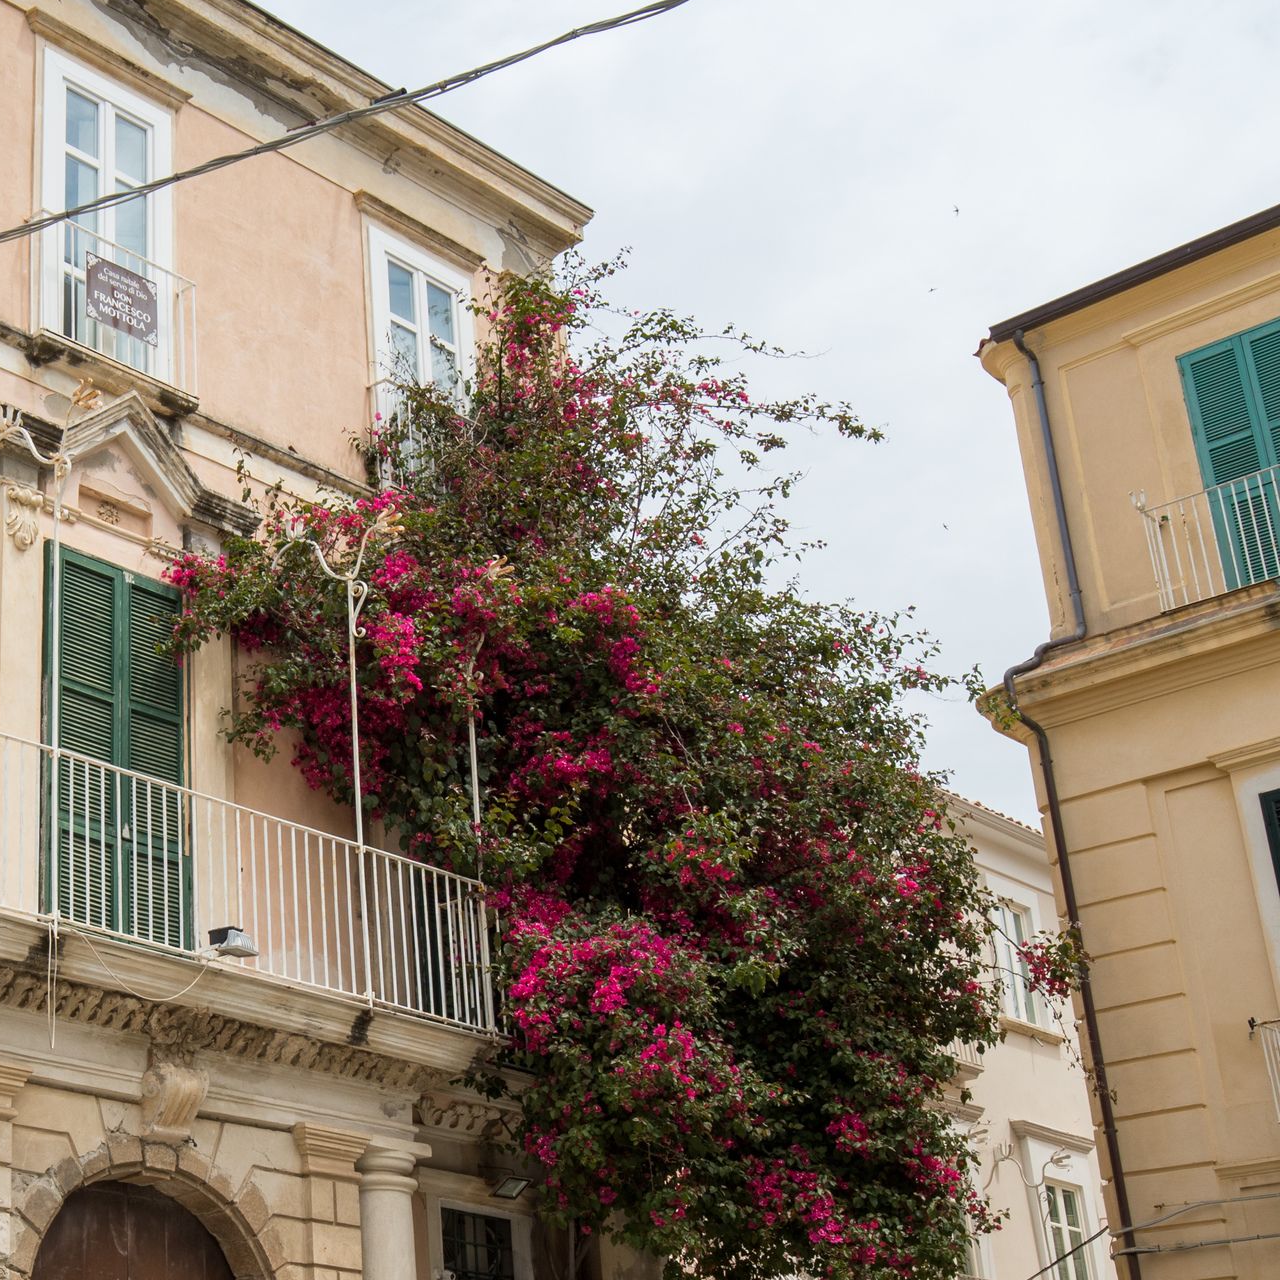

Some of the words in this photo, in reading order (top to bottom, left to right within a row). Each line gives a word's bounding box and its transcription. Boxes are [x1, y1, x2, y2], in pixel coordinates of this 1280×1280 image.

[103, 266, 120, 280] Casa
[114, 289, 132, 305] DON
[136, 291, 148, 301] Dio
[94, 290, 151, 323] FRANCESCO
[99, 301, 146, 332] MOTTOLA
